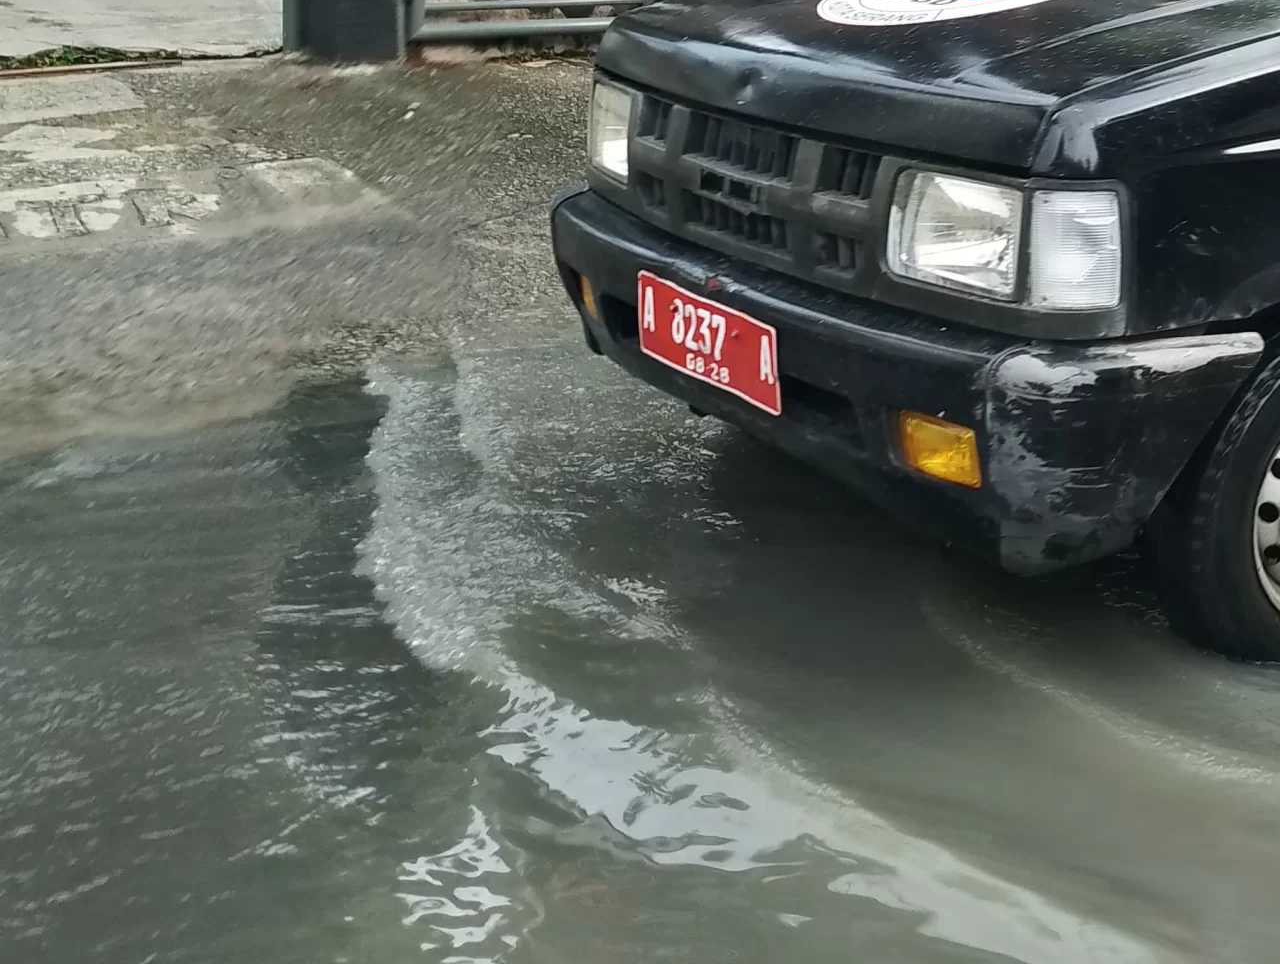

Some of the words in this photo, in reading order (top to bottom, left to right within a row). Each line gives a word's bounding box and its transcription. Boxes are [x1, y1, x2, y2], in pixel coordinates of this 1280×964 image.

[643, 286, 656, 333] A
[671, 298, 726, 361] 8237
[760, 335, 774, 384] A
